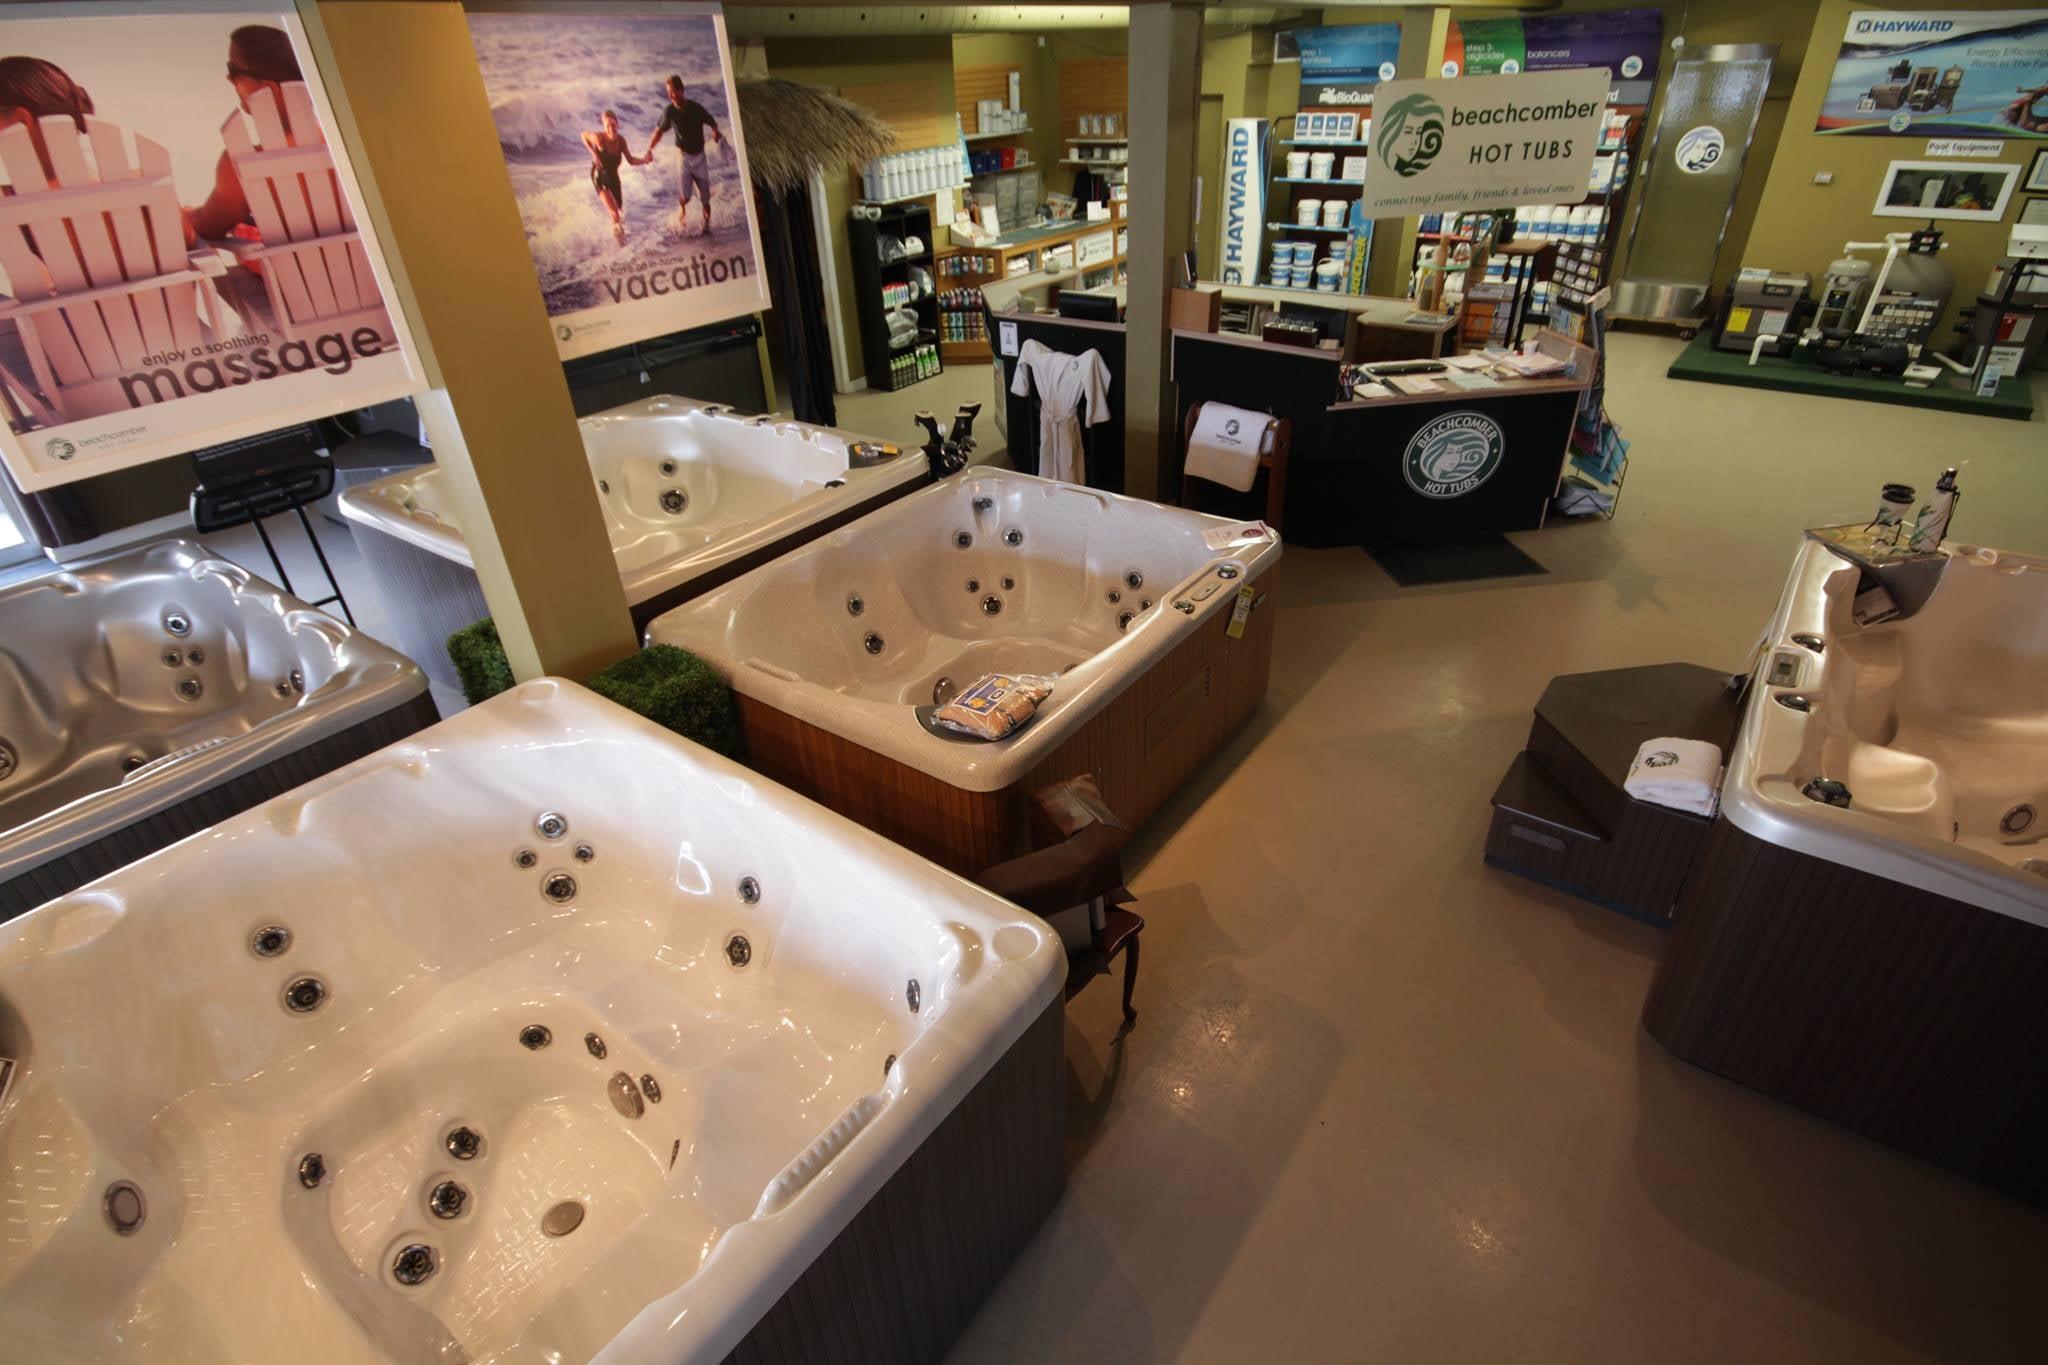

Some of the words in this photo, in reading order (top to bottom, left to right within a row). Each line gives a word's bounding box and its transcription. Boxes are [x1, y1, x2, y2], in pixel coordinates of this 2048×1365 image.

[1873, 20, 1953, 32] HAYWARD
[1527, 49, 1571, 59] balancers
[1966, 48, 2003, 57] Energy
[1337, 90, 1374, 104] BioGuar
[1451, 99, 1599, 126] beachcomber
[1469, 143, 1513, 164] HOT
[1522, 140, 1573, 161] TUBS
[1929, 142, 1949, 151] Pool
[1952, 142, 2001, 152] Equipment
[1226, 127, 1249, 262] HAYWARD
[1374, 191, 1432, 208] connecting
[1433, 190, 1470, 205] family,
[1470, 187, 1510, 204] friends
[1511, 189, 1519, 197] &
[1522, 184, 1551, 196] loved
[1551, 184, 1575, 193] ones
[603, 253, 747, 304] vacation
[142, 350, 186, 367] enjoy
[192, 344, 203, 356] a
[206, 333, 270, 355] soothing
[119, 327, 382, 409] massage
[1417, 417, 1498, 448] BEACHCOMBER
[1424, 480, 1449, 494] HOT
[1450, 474, 1480, 493] TUBS
